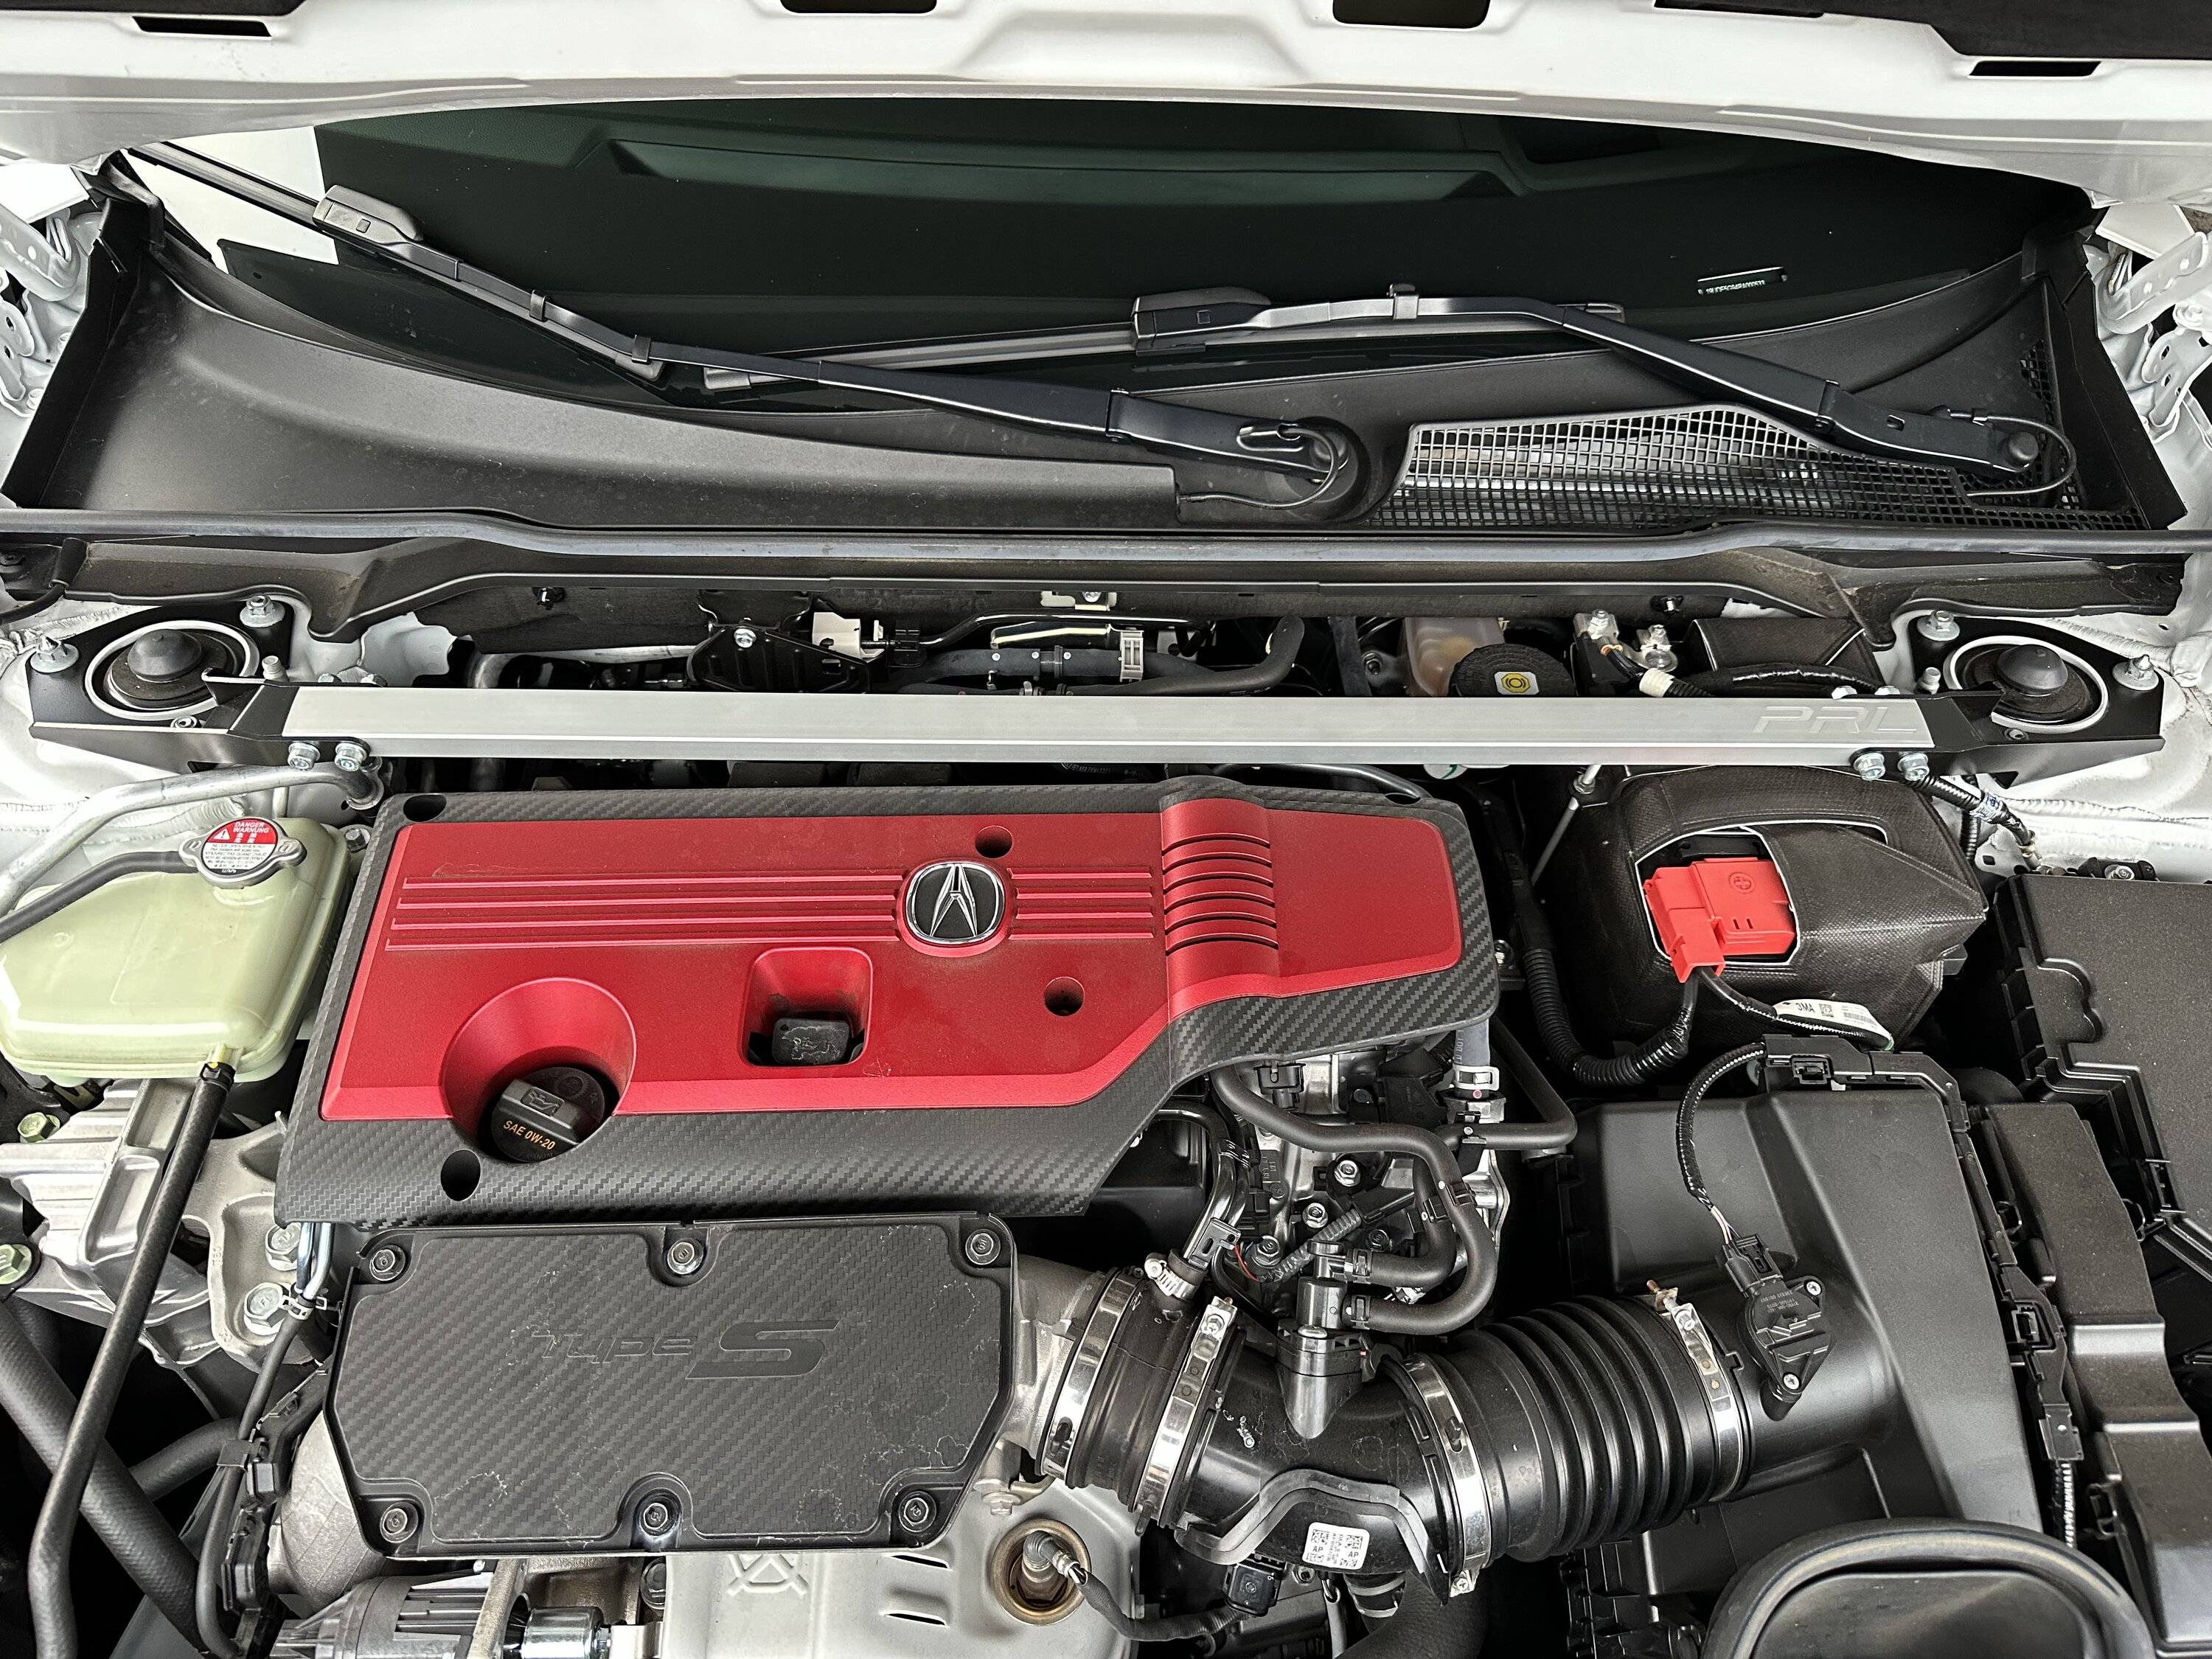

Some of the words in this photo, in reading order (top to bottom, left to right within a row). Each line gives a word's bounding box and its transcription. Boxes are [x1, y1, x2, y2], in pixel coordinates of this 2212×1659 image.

[1752, 706, 1917, 734] PRL
[1795, 1003, 1816, 1013] 3MA
[504, 1121, 526, 1135] SAE
[524, 1130, 555, 1150] 0W-20
[531, 1327, 698, 1364] Type
[685, 1320, 841, 1380] S
